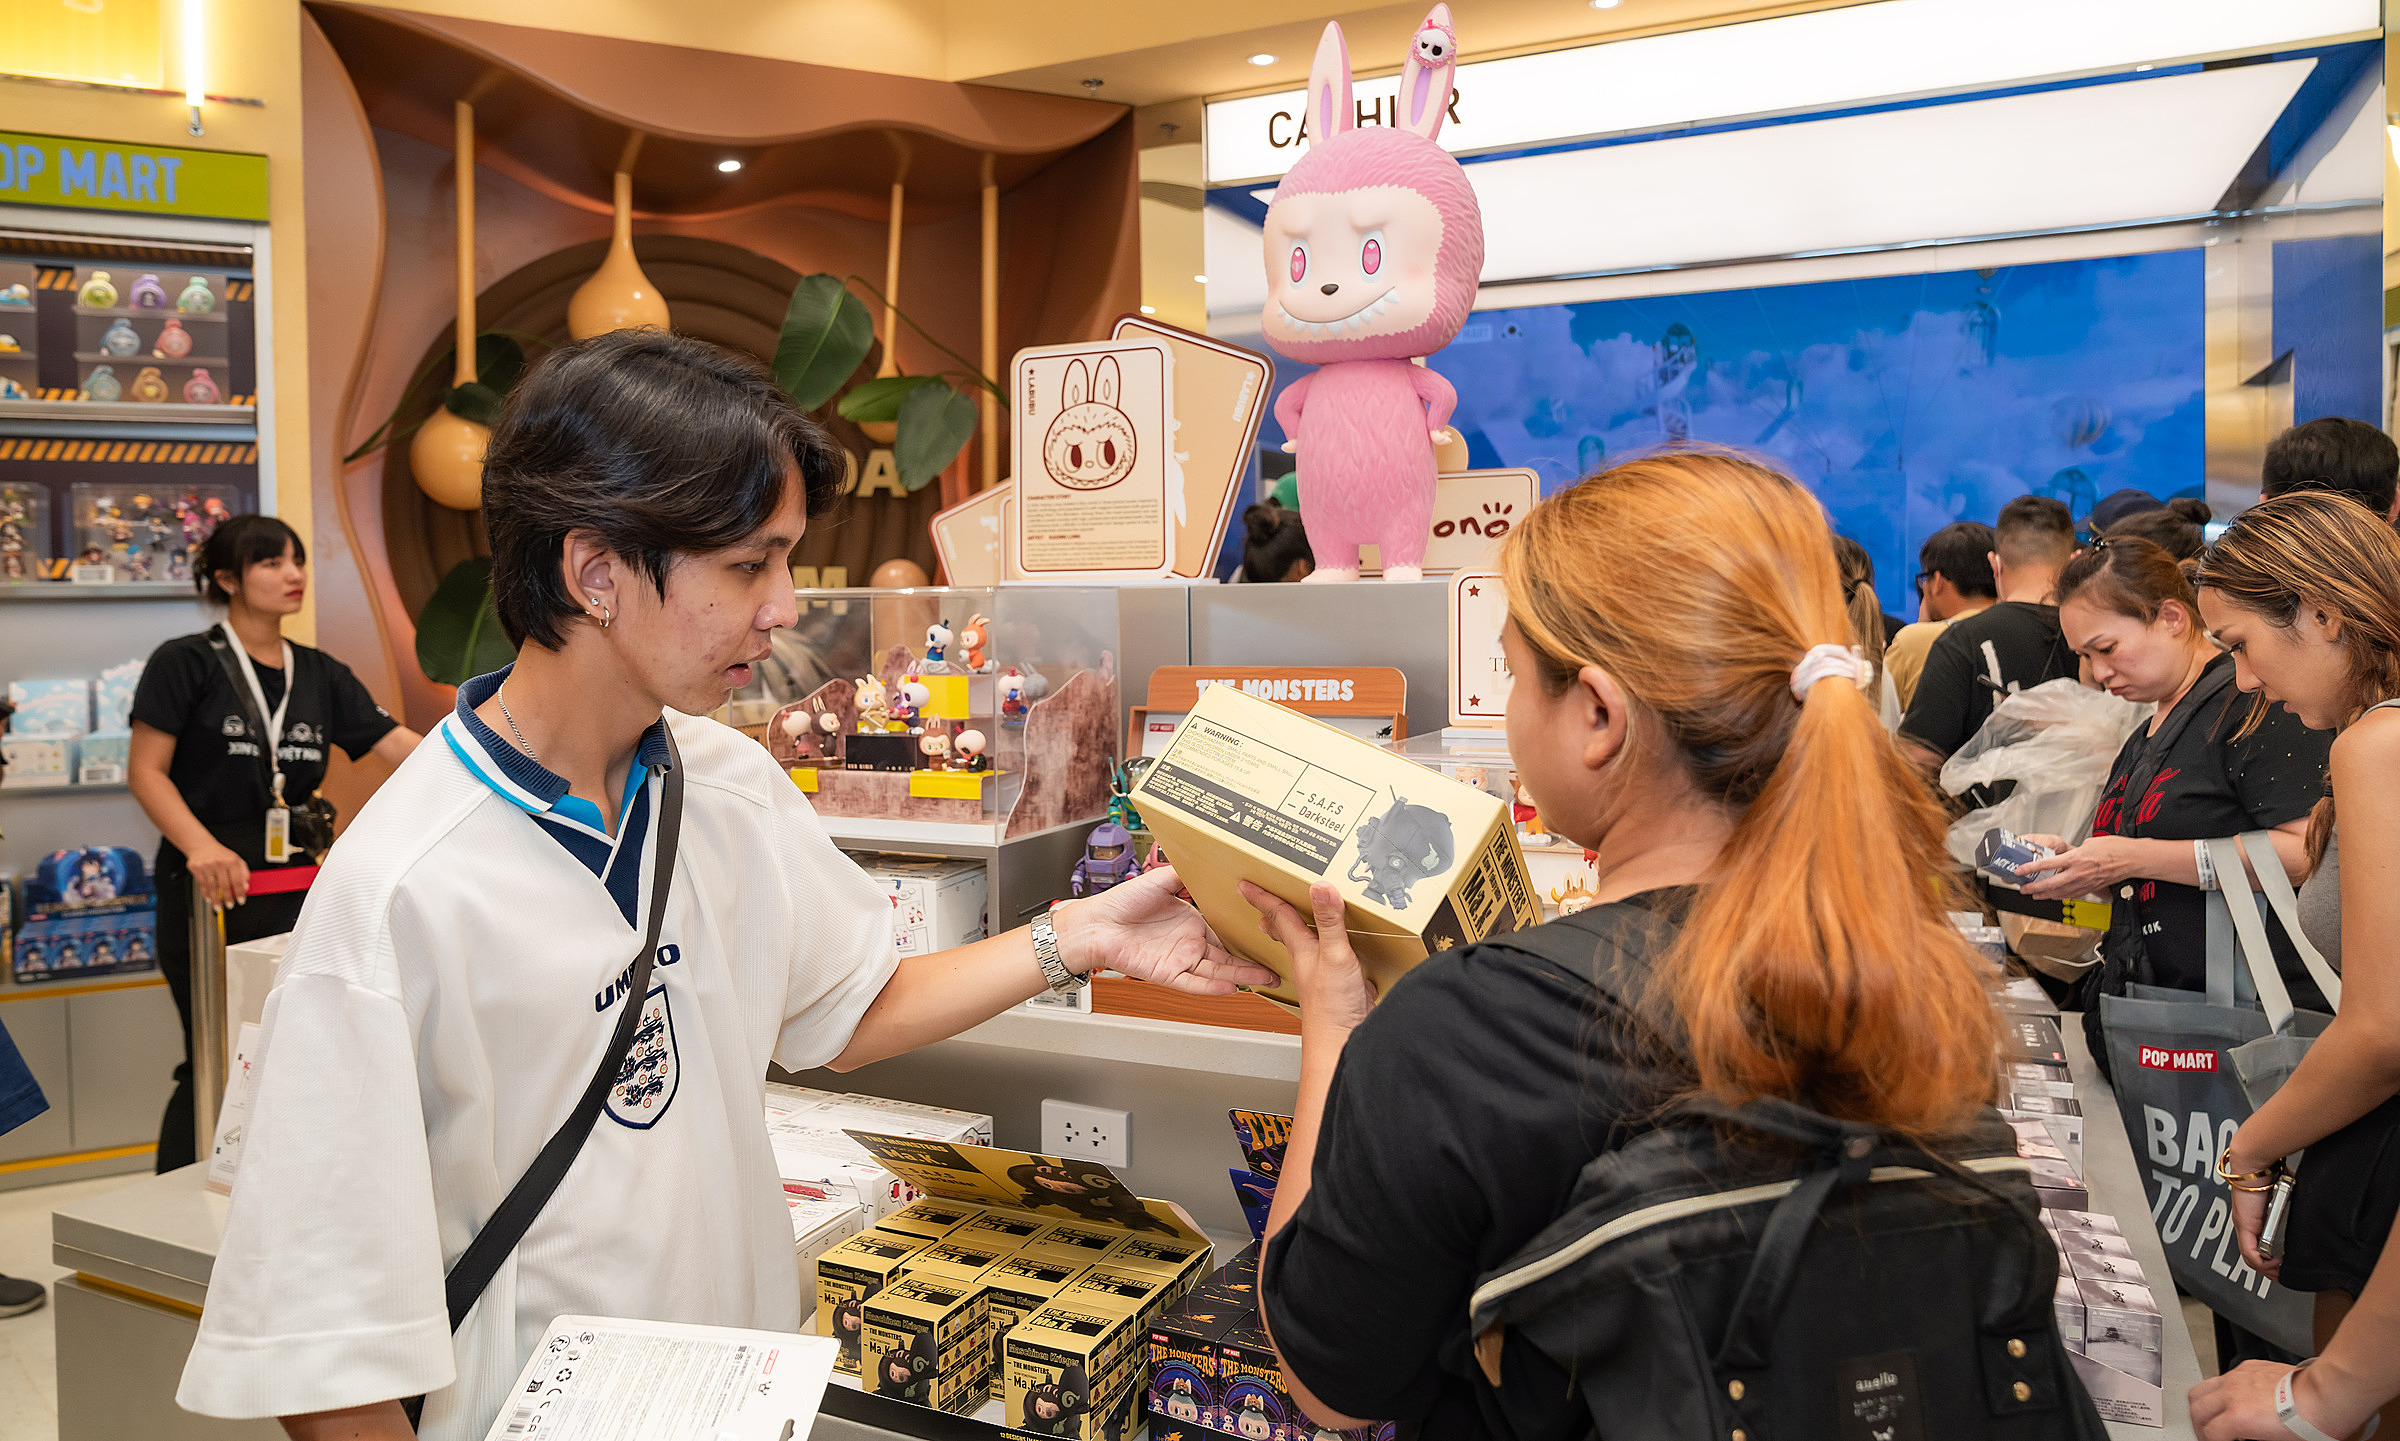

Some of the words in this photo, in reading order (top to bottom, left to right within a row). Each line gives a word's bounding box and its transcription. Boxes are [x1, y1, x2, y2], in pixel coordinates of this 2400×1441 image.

[0, 142, 45, 192] OP
[59, 147, 182, 203] MART
[1242, 679, 1354, 702] MONSTERS
[1308, 793, 1344, 815] S.A.F.S
[1241, 815, 1264, 832] 警告
[1298, 806, 1346, 834] Darksteel
[1493, 830, 1508, 861] THE
[1500, 852, 1526, 915] MONSTERS
[2142, 1048, 2169, 1067] POP
[2173, 1050, 2214, 1070] MART
[863, 1134, 885, 1145] THE
[885, 1138, 949, 1153] MONSTERS
[2151, 1168, 2200, 1245] TO
[877, 1329, 902, 1341] MONSTERS
[1013, 1361, 1022, 1370] THE
[1022, 1362, 1050, 1375] MONSTERS
[1150, 1343, 1168, 1363] THE
[1168, 1348, 1216, 1378] MONSTERS
[1220, 1357, 1240, 1379] THE
[1241, 1364, 1289, 1394] MONSTERS
